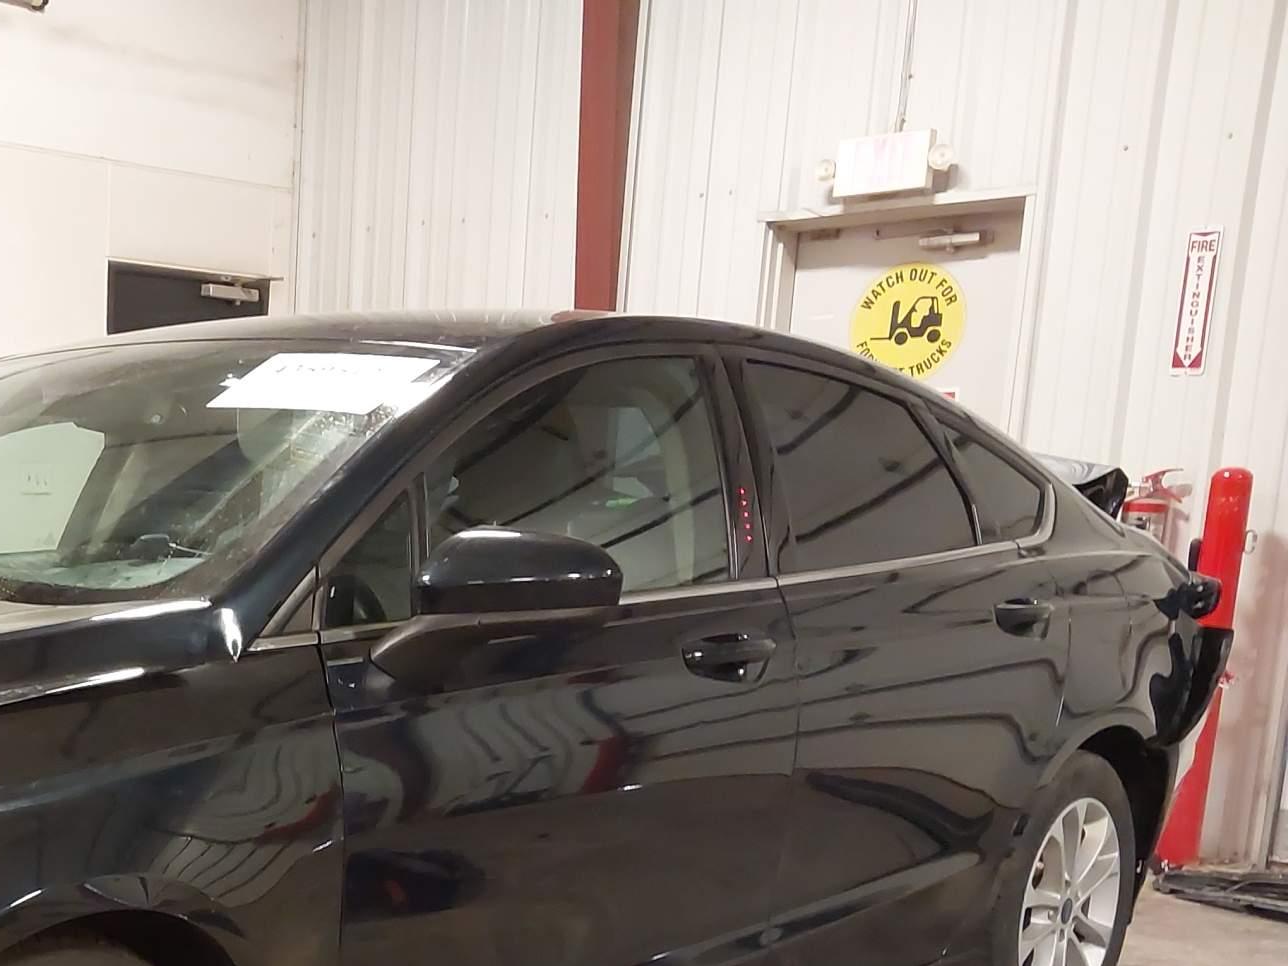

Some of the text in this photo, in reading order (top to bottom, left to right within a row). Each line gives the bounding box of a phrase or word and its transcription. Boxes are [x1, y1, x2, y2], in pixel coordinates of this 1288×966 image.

[1191, 239, 1217, 253] FIRE
[860, 267, 959, 311] WATCH OUT FOR
[909, 338, 953, 378] TRUCKS
